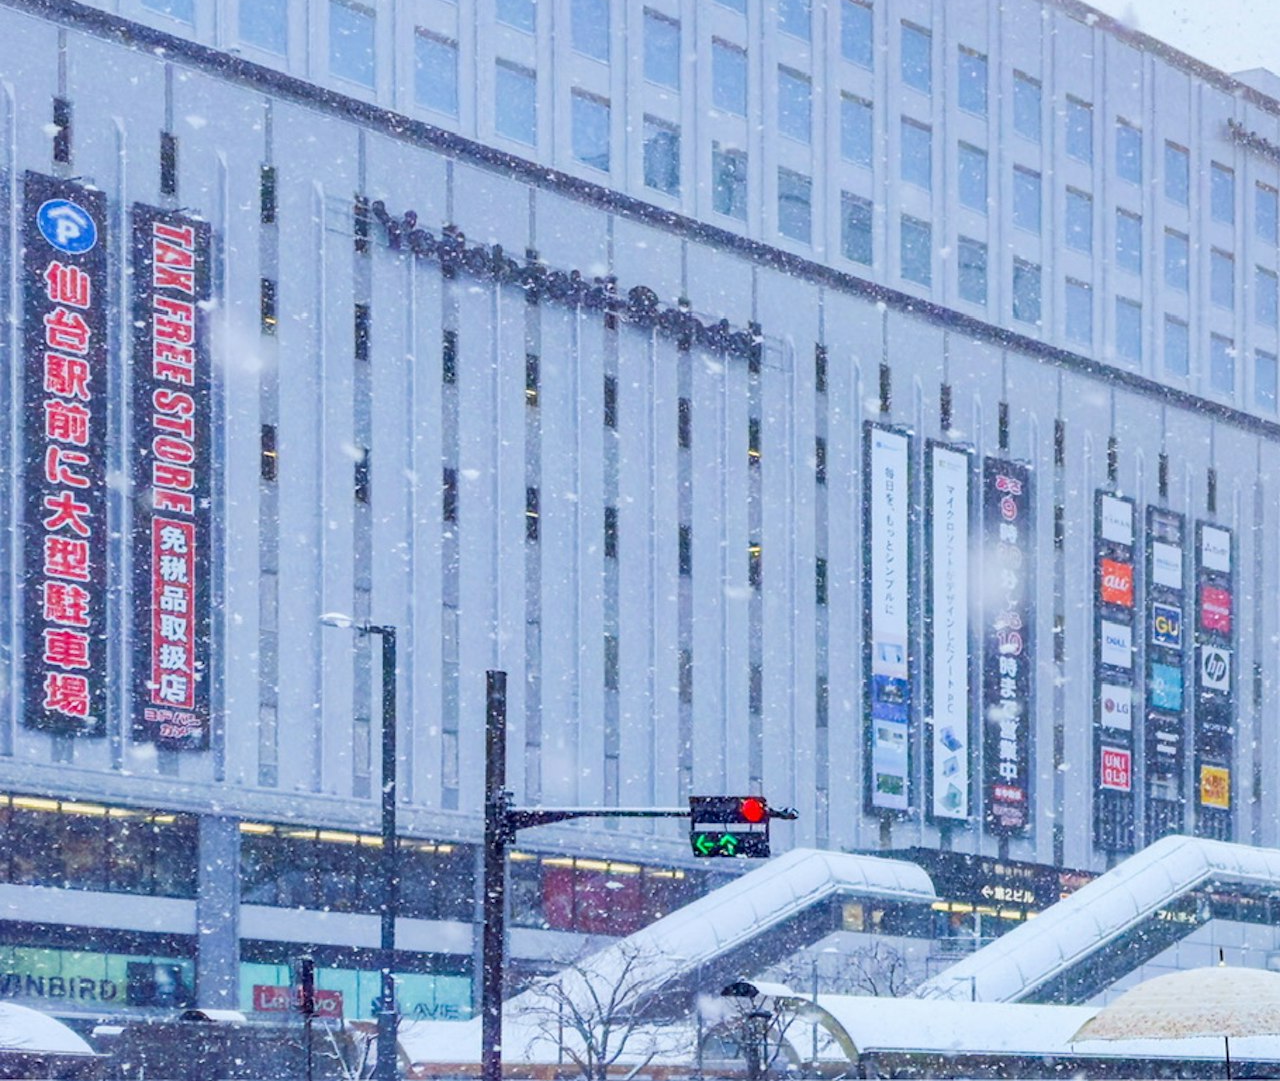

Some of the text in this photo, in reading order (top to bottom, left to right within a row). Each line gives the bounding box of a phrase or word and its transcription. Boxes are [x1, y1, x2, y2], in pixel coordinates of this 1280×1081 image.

[152, 222, 195, 515] TAX FREE STORE
[43, 260, 91, 718] 仙台駅前に大型駐車場
[1103, 575, 1130, 592] au
[160, 526, 188, 703] 免税品取扱店
[1156, 616, 1179, 636] GU
[1207, 652, 1225, 682] hp
[1116, 702, 1129, 714] LG
[1105, 754, 1125, 770] UNI
